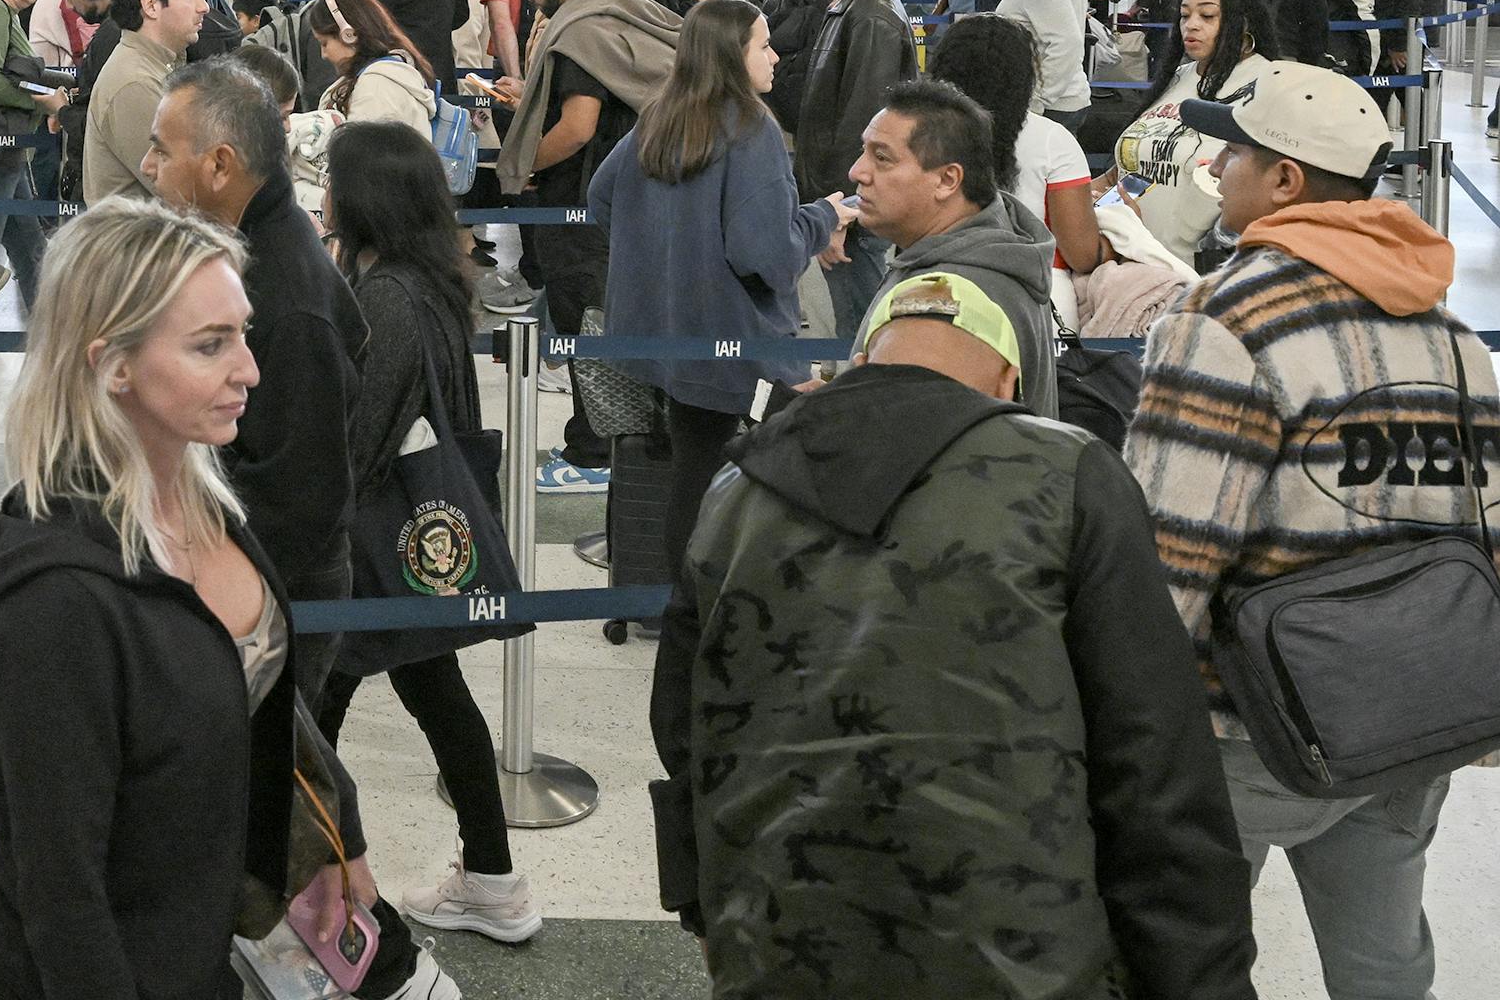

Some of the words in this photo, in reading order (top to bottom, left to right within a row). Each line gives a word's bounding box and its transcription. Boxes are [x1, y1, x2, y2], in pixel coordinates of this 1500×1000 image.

[1372, 77, 1389, 87] IAH
[475, 97, 491, 107] IAH
[0, 136, 15, 147] IAH
[1264, 128, 1300, 148] LEGACY
[59, 204, 78, 216] IAH
[565, 209, 587, 223] IAH
[550, 338, 576, 355] IAH
[715, 341, 741, 358] IAH
[397, 519, 415, 552] UNITED
[469, 596, 505, 622] IAH
